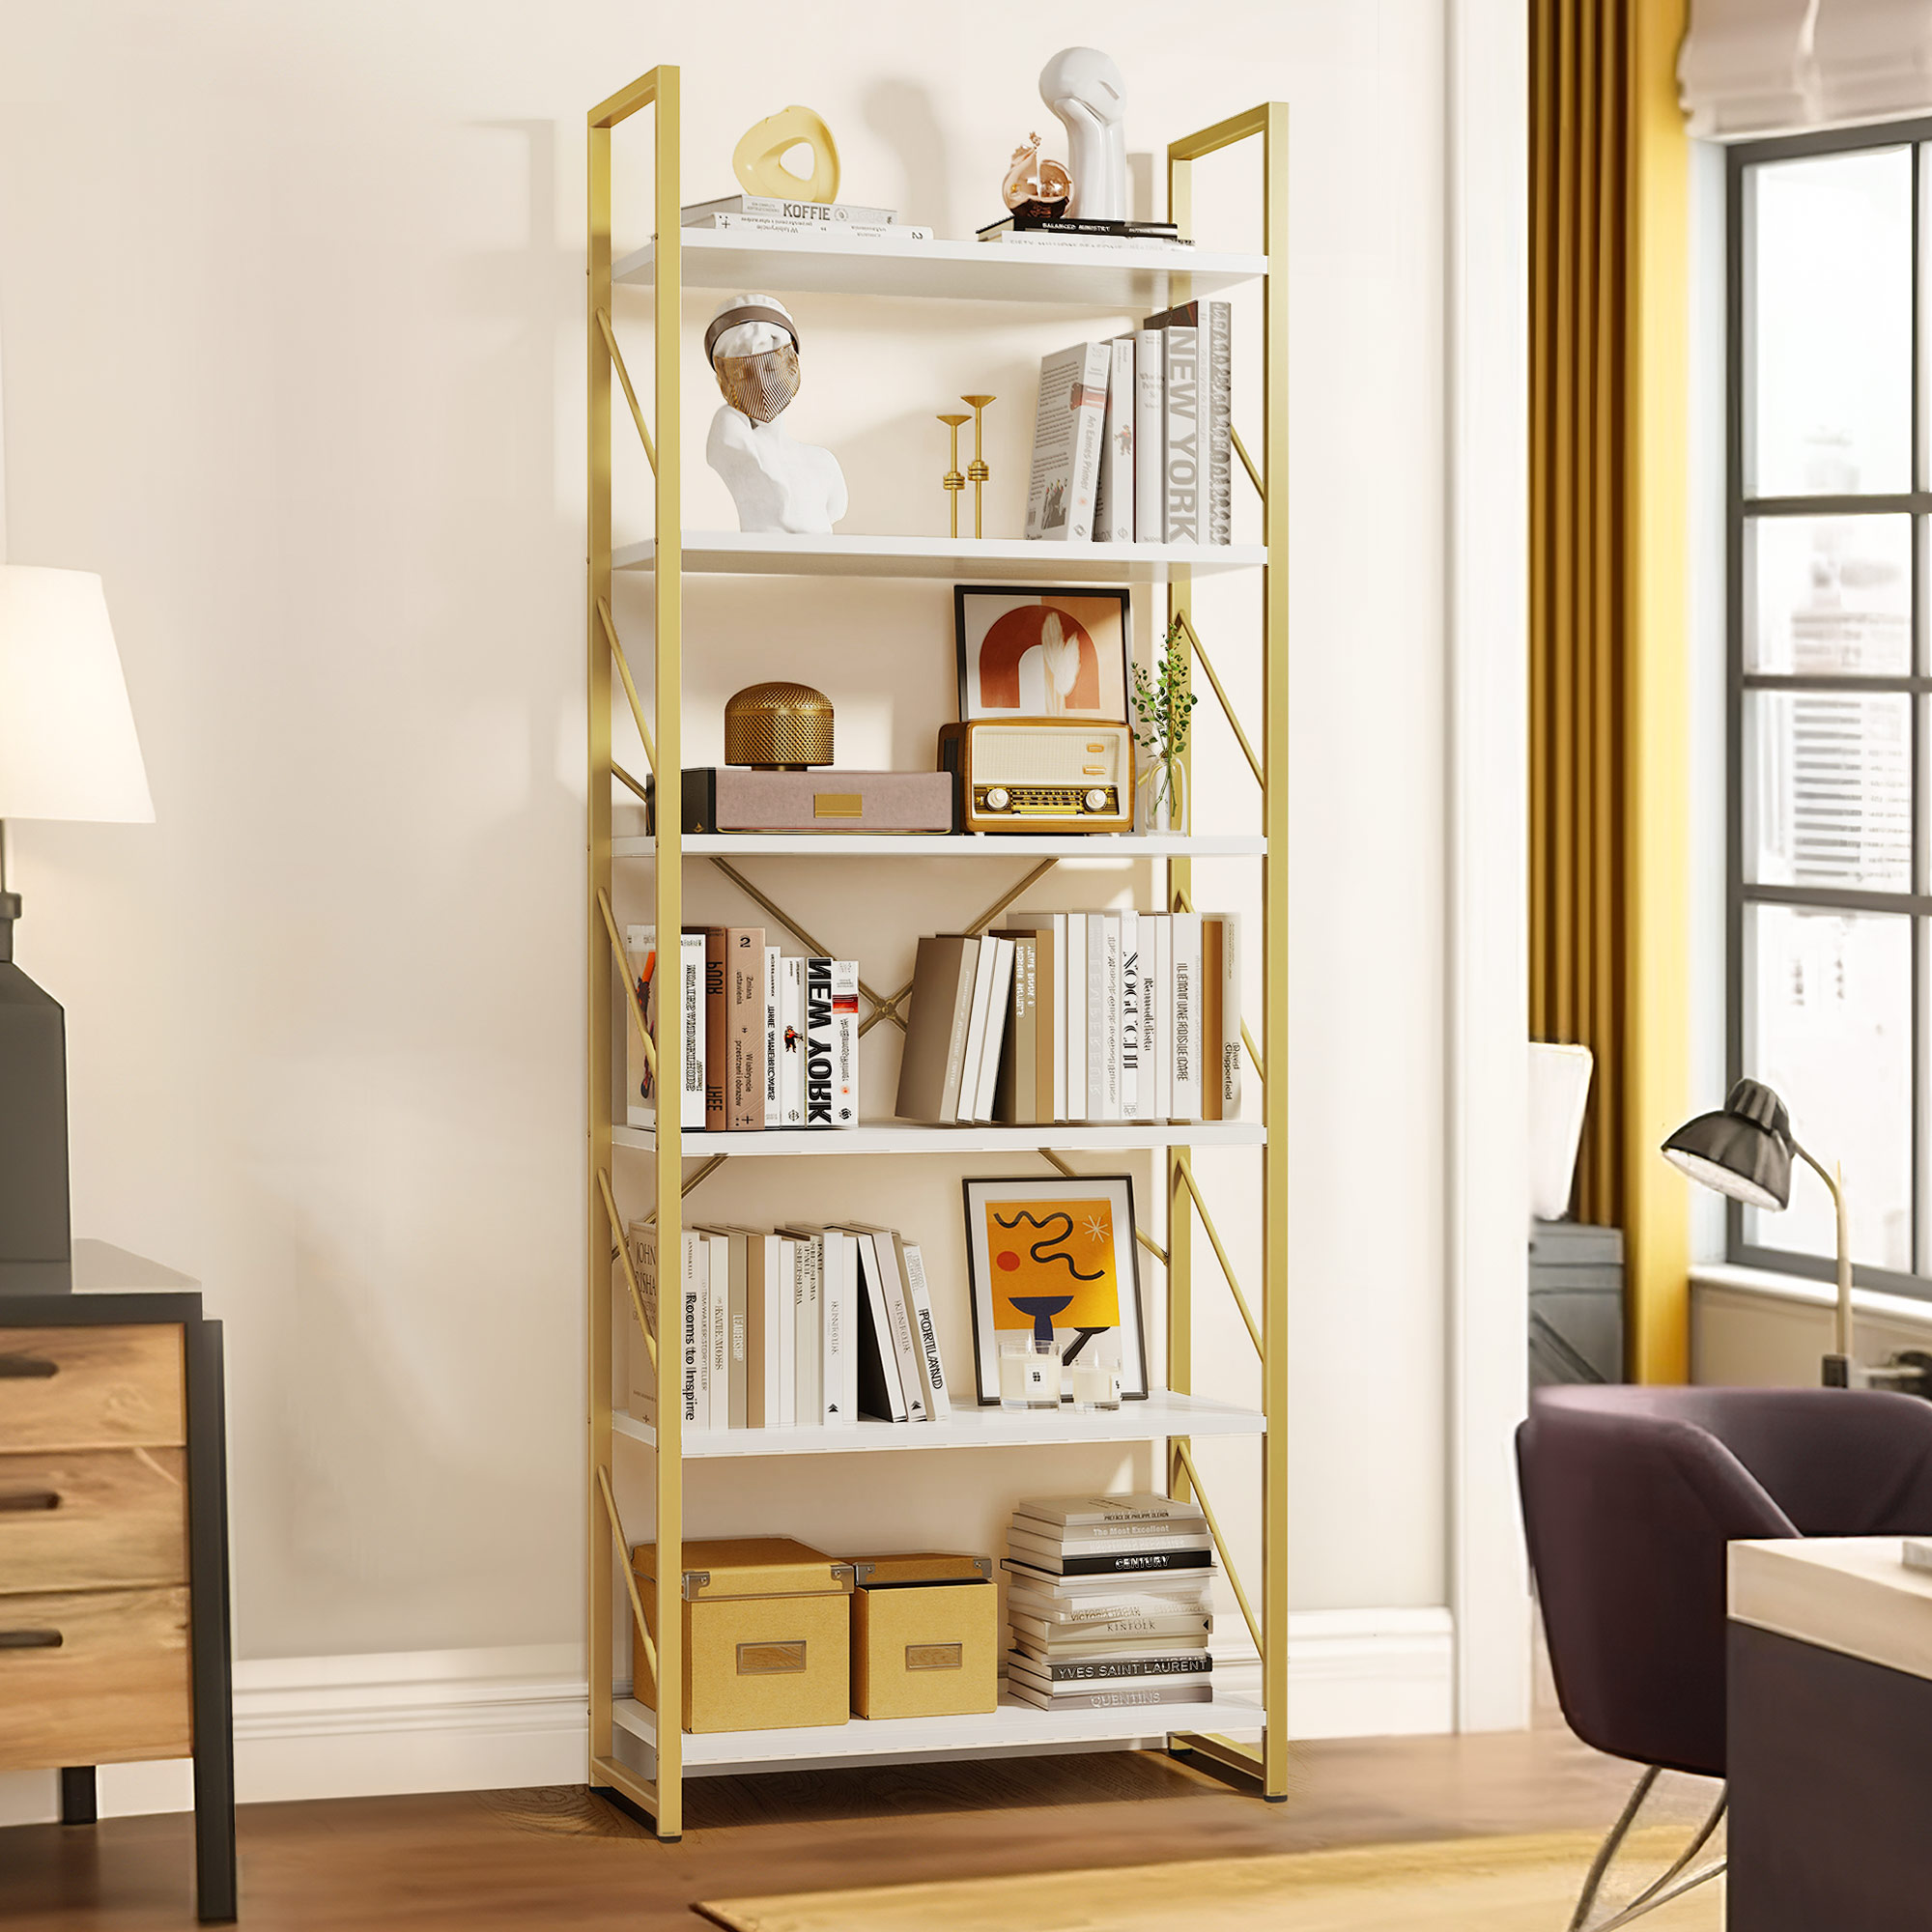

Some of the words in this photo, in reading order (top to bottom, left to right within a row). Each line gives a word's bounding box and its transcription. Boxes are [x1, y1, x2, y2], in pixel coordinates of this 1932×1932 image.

[782, 203, 831, 221] KOFFIE
[1041, 221, 1076, 231] BALANCED
[1078, 224, 1111, 233] MINISTRY
[1168, 328, 1197, 421] NEW
[1168, 431, 1198, 545] YORK
[739, 934, 752, 949] 2
[746, 976, 754, 1000] Zmiana
[1122, 951, 1139, 1069] NOGUCHI
[1144, 978, 1154, 1052] Remodelista
[734, 1040, 743, 1075] przestrzeni
[1232, 1041, 1240, 1070] David
[744, 1059, 753, 1093] labiryncie
[1223, 1041, 1233, 1100] Chipperfield
[636, 1241, 656, 1266] JOHN
[685, 1291, 697, 1345] Rooms
[685, 1346, 696, 1365] to
[714, 1338, 724, 1371] MOSS
[919, 1308, 943, 1390] PORTLAND
[682, 1366, 697, 1421] Inspire
[1093, 1527, 1109, 1537] The
[1110, 1526, 1129, 1535] Most
[1131, 1523, 1170, 1534] Excellent
[1115, 1555, 1171, 1570] CENTURY
[1107, 1622, 1156, 1633] KINFOLK
[1059, 1664, 1095, 1679] YVES
[1097, 1662, 1141, 1677] SAINT
[1144, 1659, 1208, 1675] LAURENT
[1090, 1691, 1161, 1709] QUENTINS
